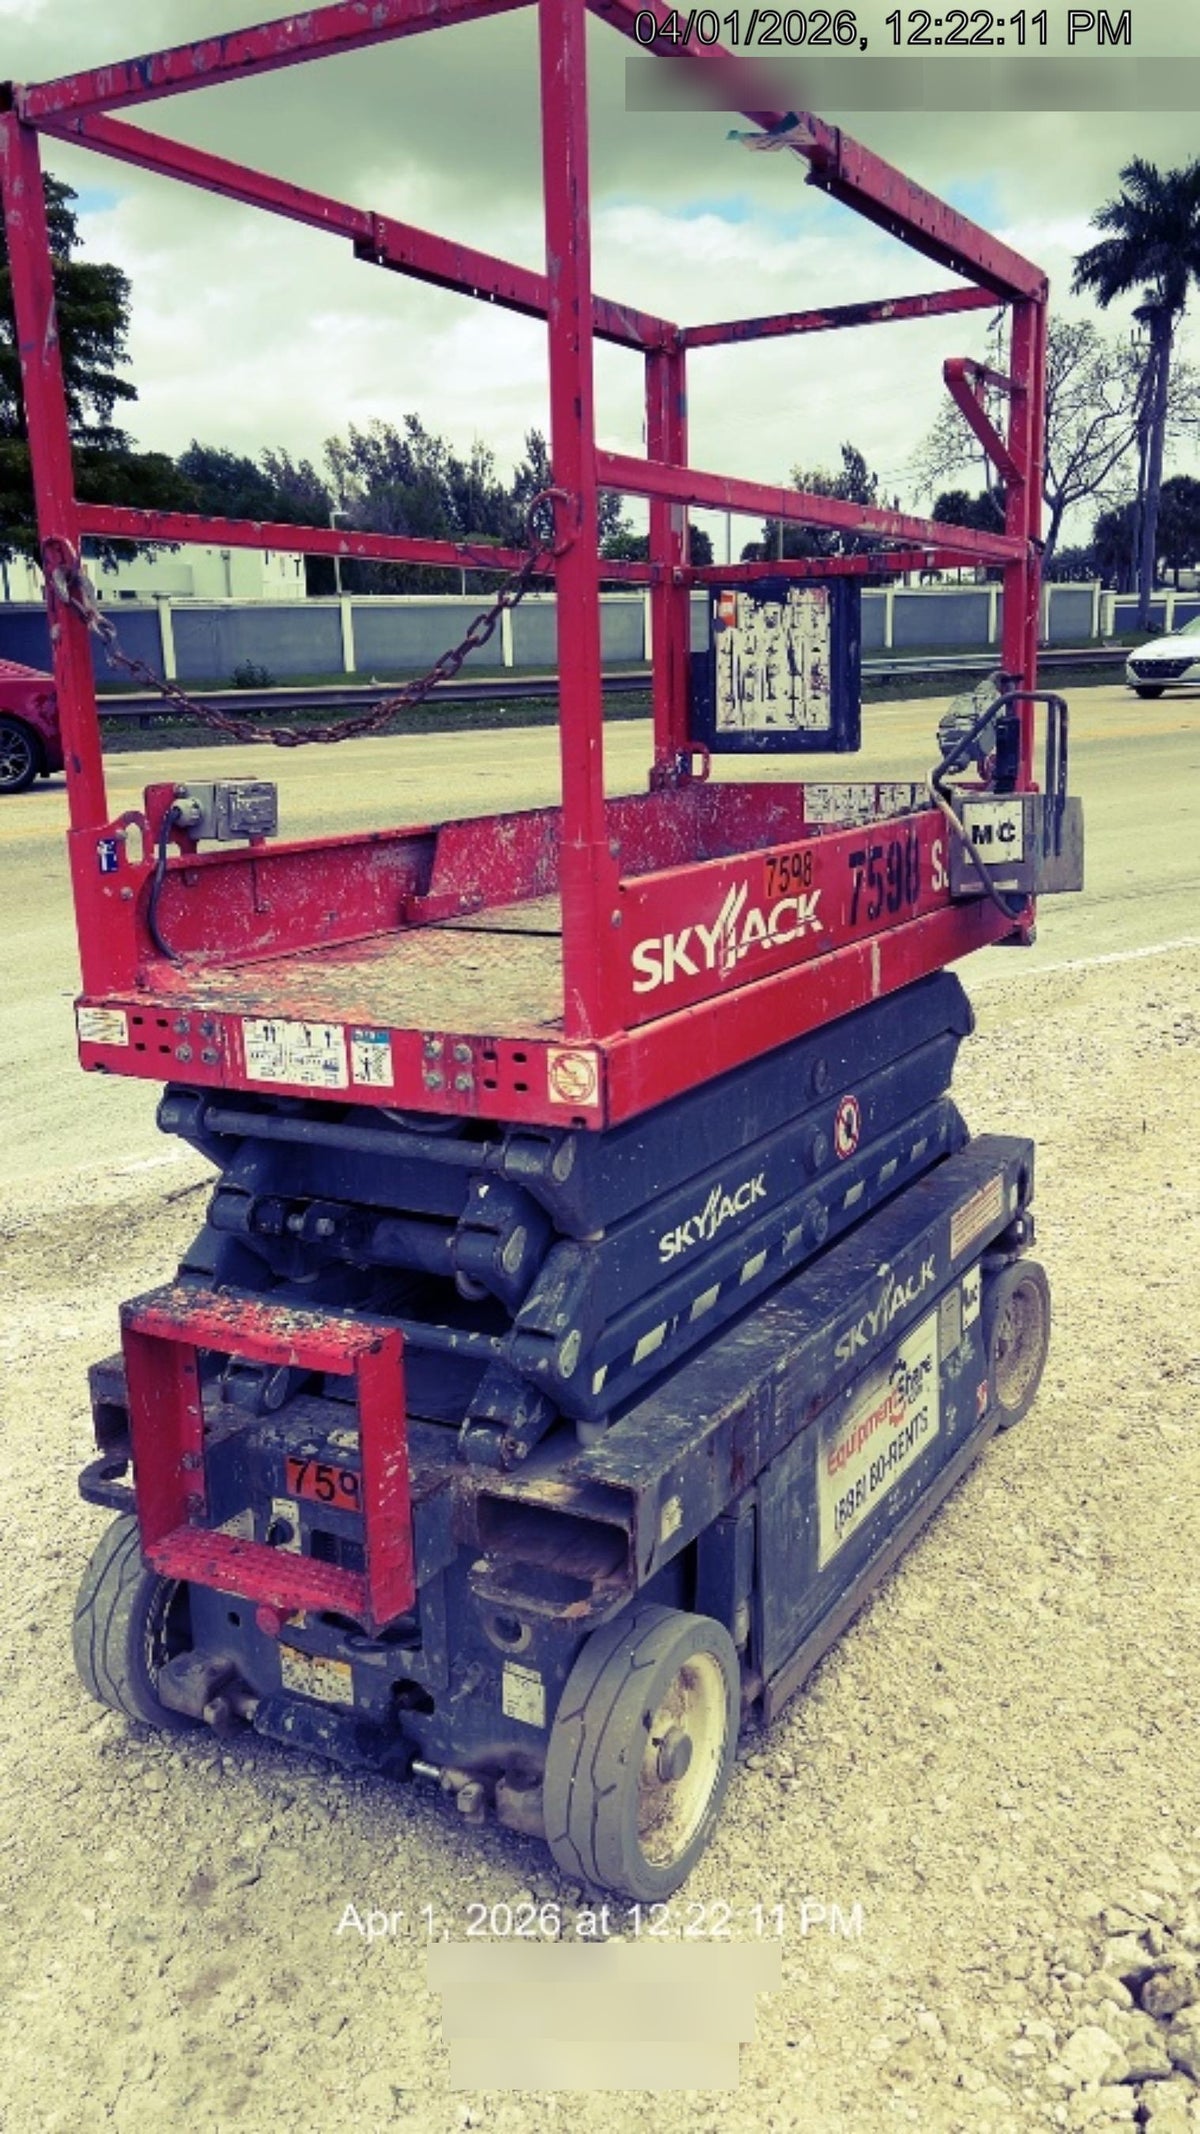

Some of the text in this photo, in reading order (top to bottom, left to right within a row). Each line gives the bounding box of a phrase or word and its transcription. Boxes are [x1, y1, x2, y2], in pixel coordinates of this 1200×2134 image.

[765, 850, 813, 897] 7598
[630, 880, 824, 993] SKYJACK
[658, 1172, 767, 1263] SKYJACK
[834, 1253, 936, 1370] SKYJACK
